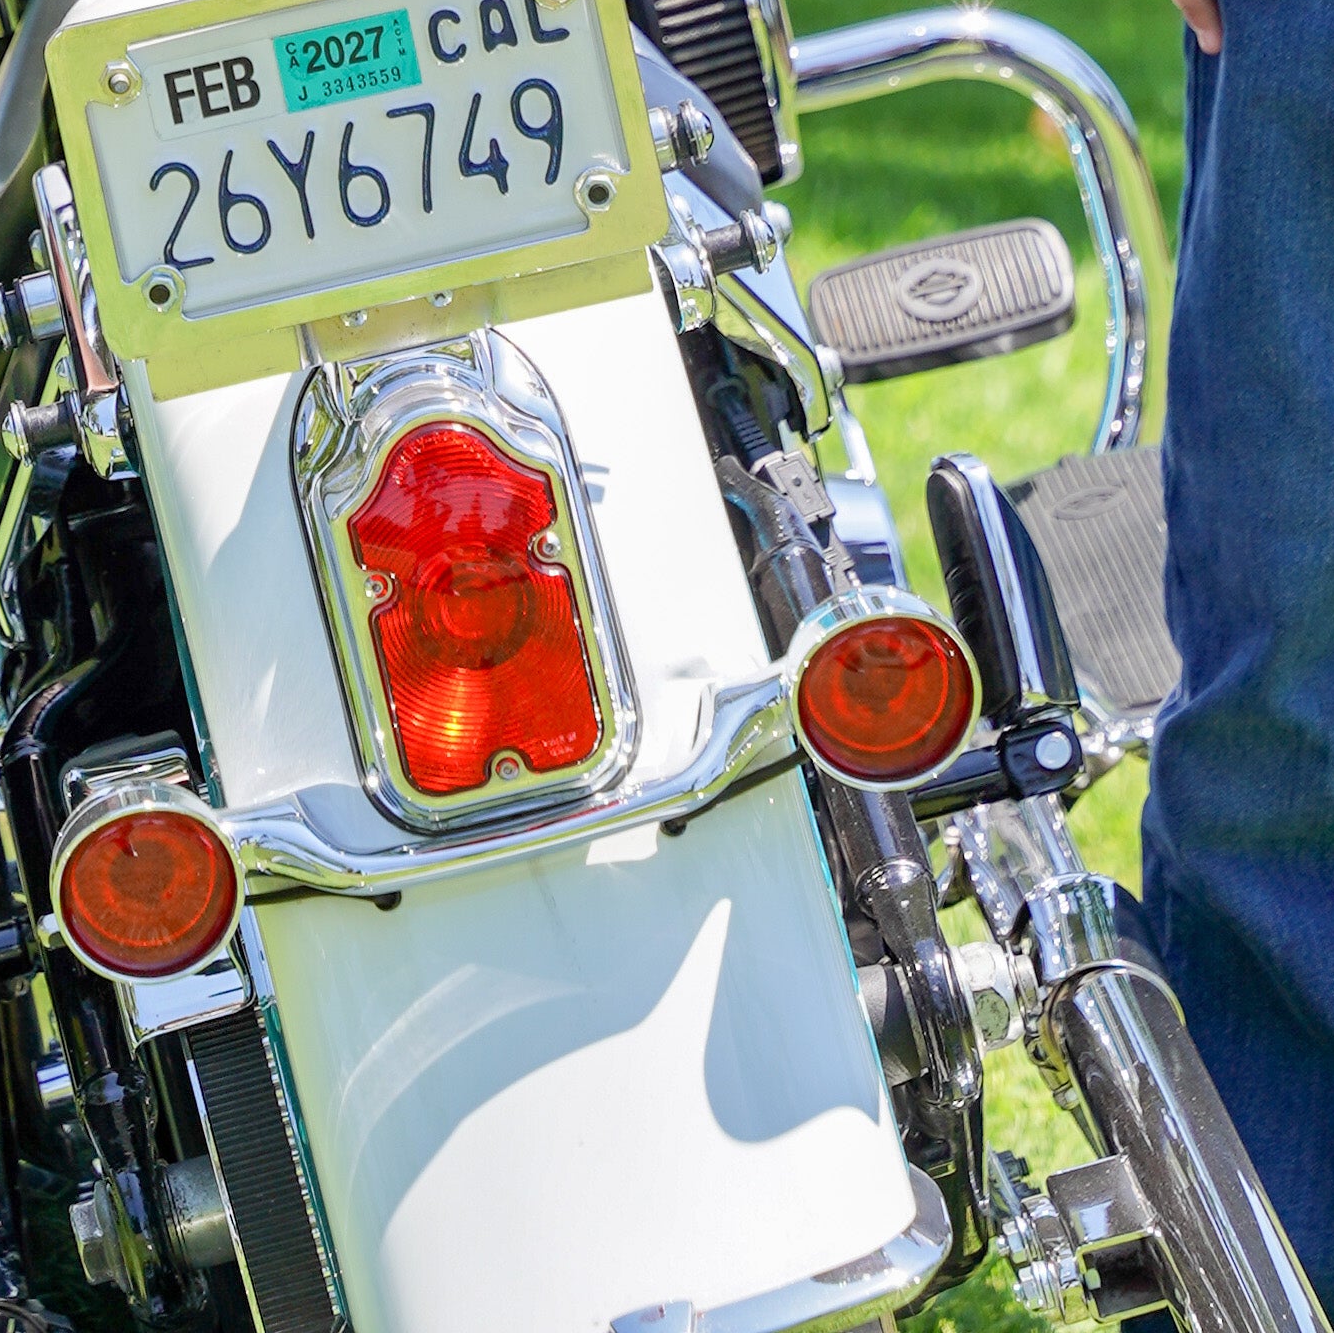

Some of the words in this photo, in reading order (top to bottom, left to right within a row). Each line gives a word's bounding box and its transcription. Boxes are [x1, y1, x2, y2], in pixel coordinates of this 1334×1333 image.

[302, 25, 384, 75] 2027
[164, 55, 262, 124] FEB
[322, 66, 402, 97] 3343559
[148, 77, 564, 270] 26Y6749
